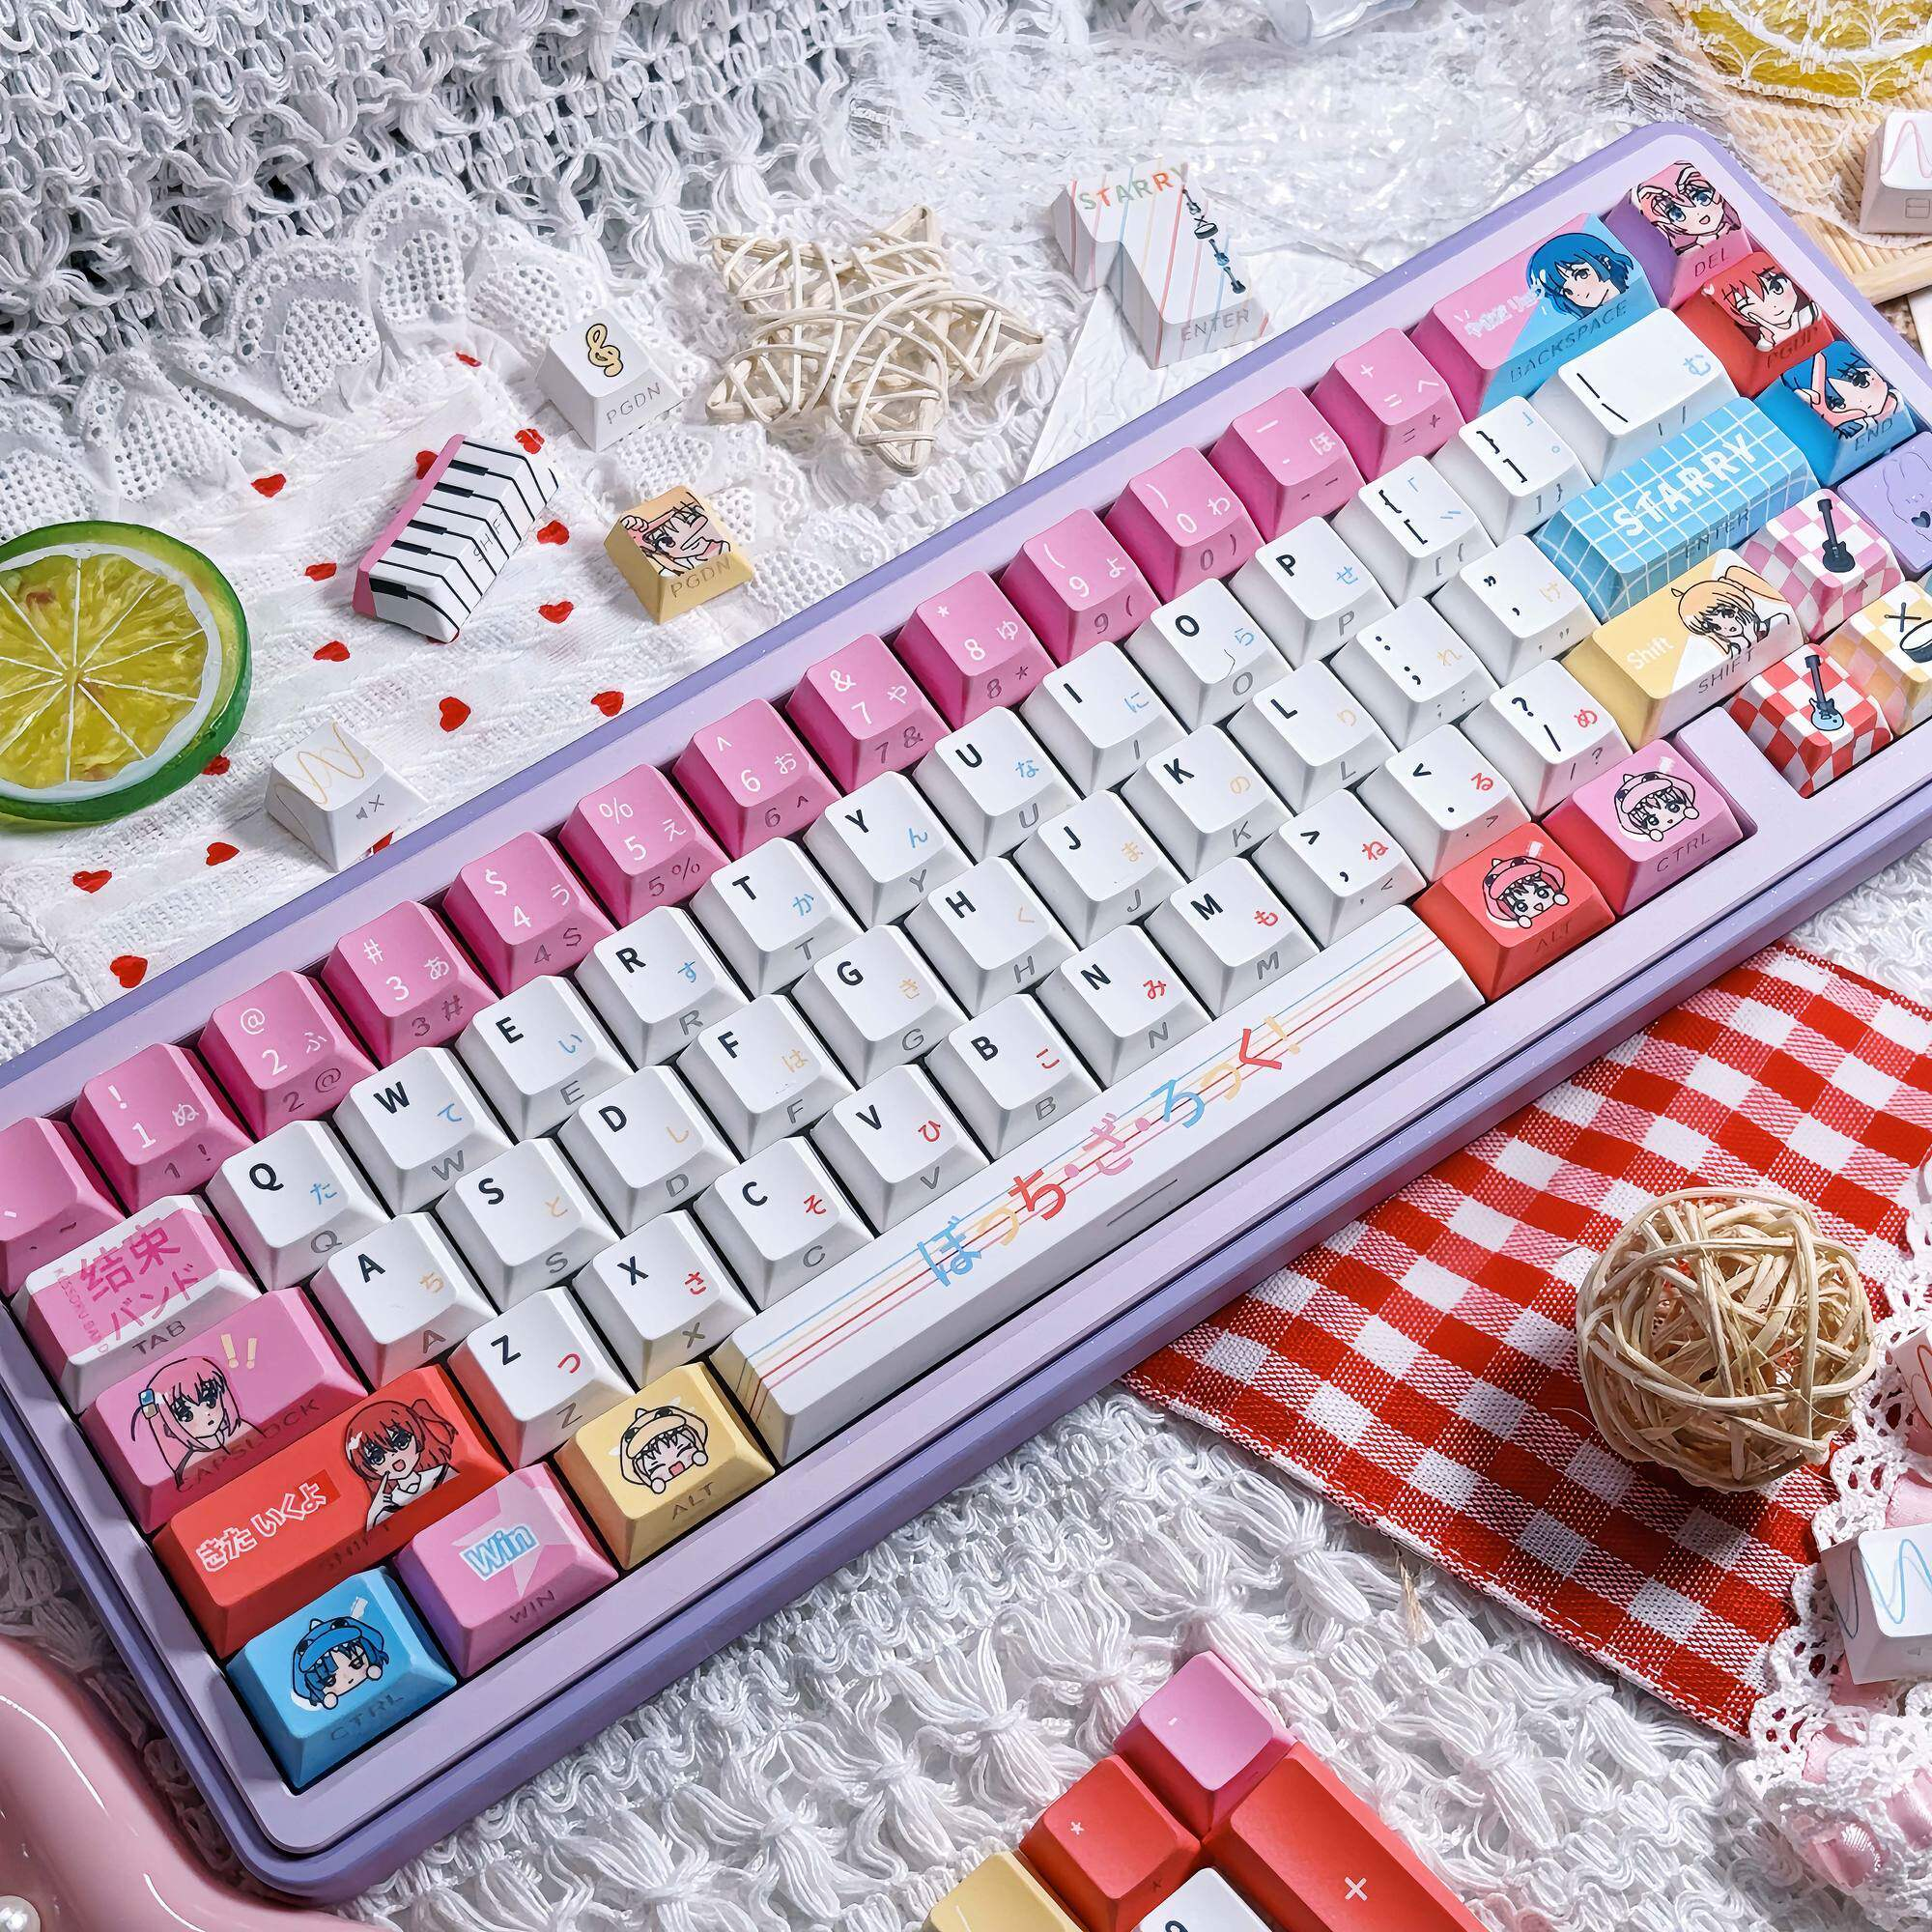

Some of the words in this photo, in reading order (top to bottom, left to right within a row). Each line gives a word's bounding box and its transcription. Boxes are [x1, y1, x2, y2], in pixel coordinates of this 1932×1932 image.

[1079, 161, 1189, 211] STARRY
[1694, 248, 1729, 277] DEL
[1180, 307, 1249, 341] ENTER
[606, 383, 662, 424] PGDN
[1309, 432, 1336, 456] ほ
[1855, 417, 1893, 451] END
[1612, 435, 1756, 536] STARRY
[1176, 513, 1198, 534] 0
[1200, 549, 1214, 571] 0
[1275, 554, 1297, 577] P
[670, 555, 731, 599] PGDN
[1068, 576, 1090, 599] 9
[1094, 613, 1109, 635] 9
[1175, 614, 1200, 638] O
[1338, 611, 1355, 636] P
[963, 638, 986, 662] 8
[995, 620, 1019, 640] ゆ
[1626, 634, 1676, 670] Shift
[1232, 671, 1254, 696] O
[1698, 646, 1755, 694] SHIFT
[986, 678, 1004, 699] 8
[1063, 683, 1083, 703] I
[850, 701, 872, 724] 7
[887, 685, 908, 705] や
[1270, 698, 1298, 720] L
[874, 741, 890, 764] 7
[955, 743, 983, 769] U
[740, 769, 761, 793] 6
[774, 752, 797, 775] お
[1163, 757, 1195, 785] K
[1340, 761, 1356, 781] L
[764, 807, 781, 828] 6
[844, 809, 869, 834] Y
[1018, 803, 1039, 829] U
[623, 835, 647, 862] 5
[663, 818, 687, 842] え
[1063, 826, 1082, 850] J
[1232, 820, 1252, 848] K
[1656, 832, 1712, 872] CTRL
[648, 875, 666, 897] 5
[731, 875, 757, 900] T
[908, 869, 927, 894] Y
[945, 890, 977, 919] H
[1126, 889, 1141, 913] J
[1190, 893, 1224, 921] M
[511, 904, 532, 929] 4
[533, 945, 552, 963] 4
[615, 947, 647, 974] R
[794, 937, 814, 960] T
[386, 976, 410, 1001] 3
[423, 956, 449, 980] あ
[837, 960, 865, 986] G
[1013, 955, 1036, 983] H
[1080, 963, 1112, 991] N
[1256, 951, 1280, 980] M
[412, 1017, 431, 1037] 3
[496, 1016, 525, 1044] E
[678, 1009, 704, 1036] R
[1148, 1021, 1169, 1049] N
[717, 1031, 739, 1059] F
[901, 1028, 924, 1051] G
[970, 1035, 999, 1062] B
[262, 1049, 288, 1076] 2
[283, 1092, 305, 1113] 2
[373, 1081, 411, 1114] W
[559, 1080, 585, 1106] E
[598, 1105, 628, 1134] D
[786, 1098, 804, 1123] F
[856, 1104, 883, 1130] V
[1035, 1096, 1057, 1121] B
[132, 1122, 156, 1149] 1
[172, 1102, 200, 1126] ぬ
[164, 1162, 181, 1179] 1
[248, 1162, 285, 1191] Q
[432, 1150, 466, 1180] W
[920, 1165, 940, 1190] V
[477, 1177, 505, 1206] S
[665, 1174, 690, 1198] D
[742, 1180, 768, 1207] C
[310, 1230, 343, 1254] Q
[356, 1253, 386, 1283] A
[545, 1251, 569, 1274] S
[803, 1245, 826, 1268] C
[616, 1256, 649, 1286] X
[108, 1263, 199, 1341] バンド
[131, 1320, 185, 1354] TAB
[421, 1329, 446, 1353] A
[681, 1321, 706, 1349] X
[490, 1334, 522, 1366] Z
[555, 1402, 583, 1430] Z
[671, 1481, 716, 1520] ALT
[461, 1524, 538, 1579] Win
[510, 1589, 555, 1623] WIN
[330, 1694, 405, 1741] CTRL
